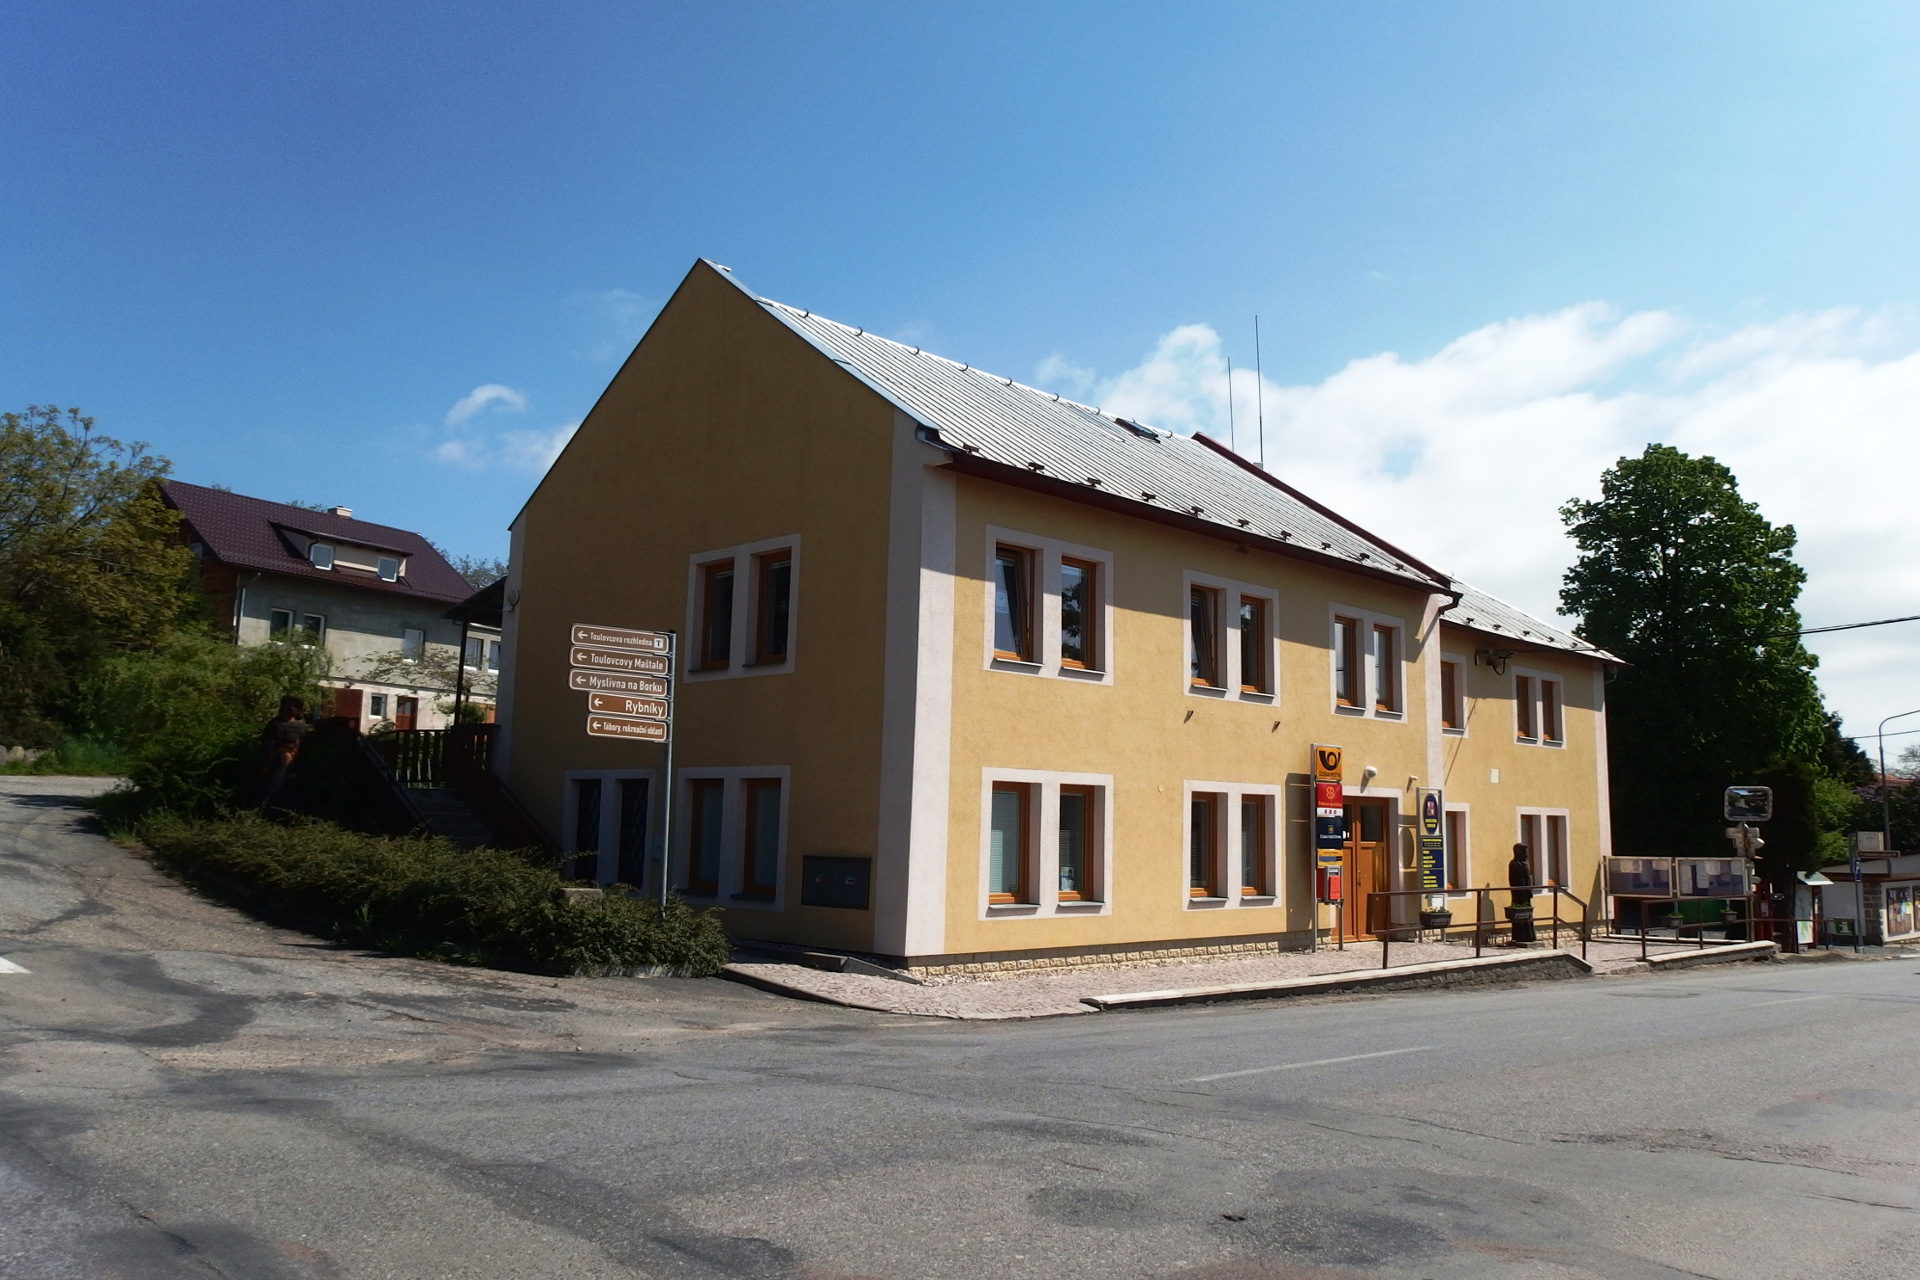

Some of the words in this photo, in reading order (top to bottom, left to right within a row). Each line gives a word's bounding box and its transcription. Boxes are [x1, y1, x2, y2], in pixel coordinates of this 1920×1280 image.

[590, 632, 623, 643] Toulovcova
[624, 637, 652, 646] rozhledna
[591, 653, 633, 669] Toulovcovy
[634, 658, 663, 669] Maštale
[589, 676, 626, 689] Myslivna
[627, 682, 638, 690] na
[639, 681, 662, 692] Borku
[625, 700, 663, 717] Rybníky
[622, 724, 647, 734] rekreační
[647, 727, 663, 735] oblast
